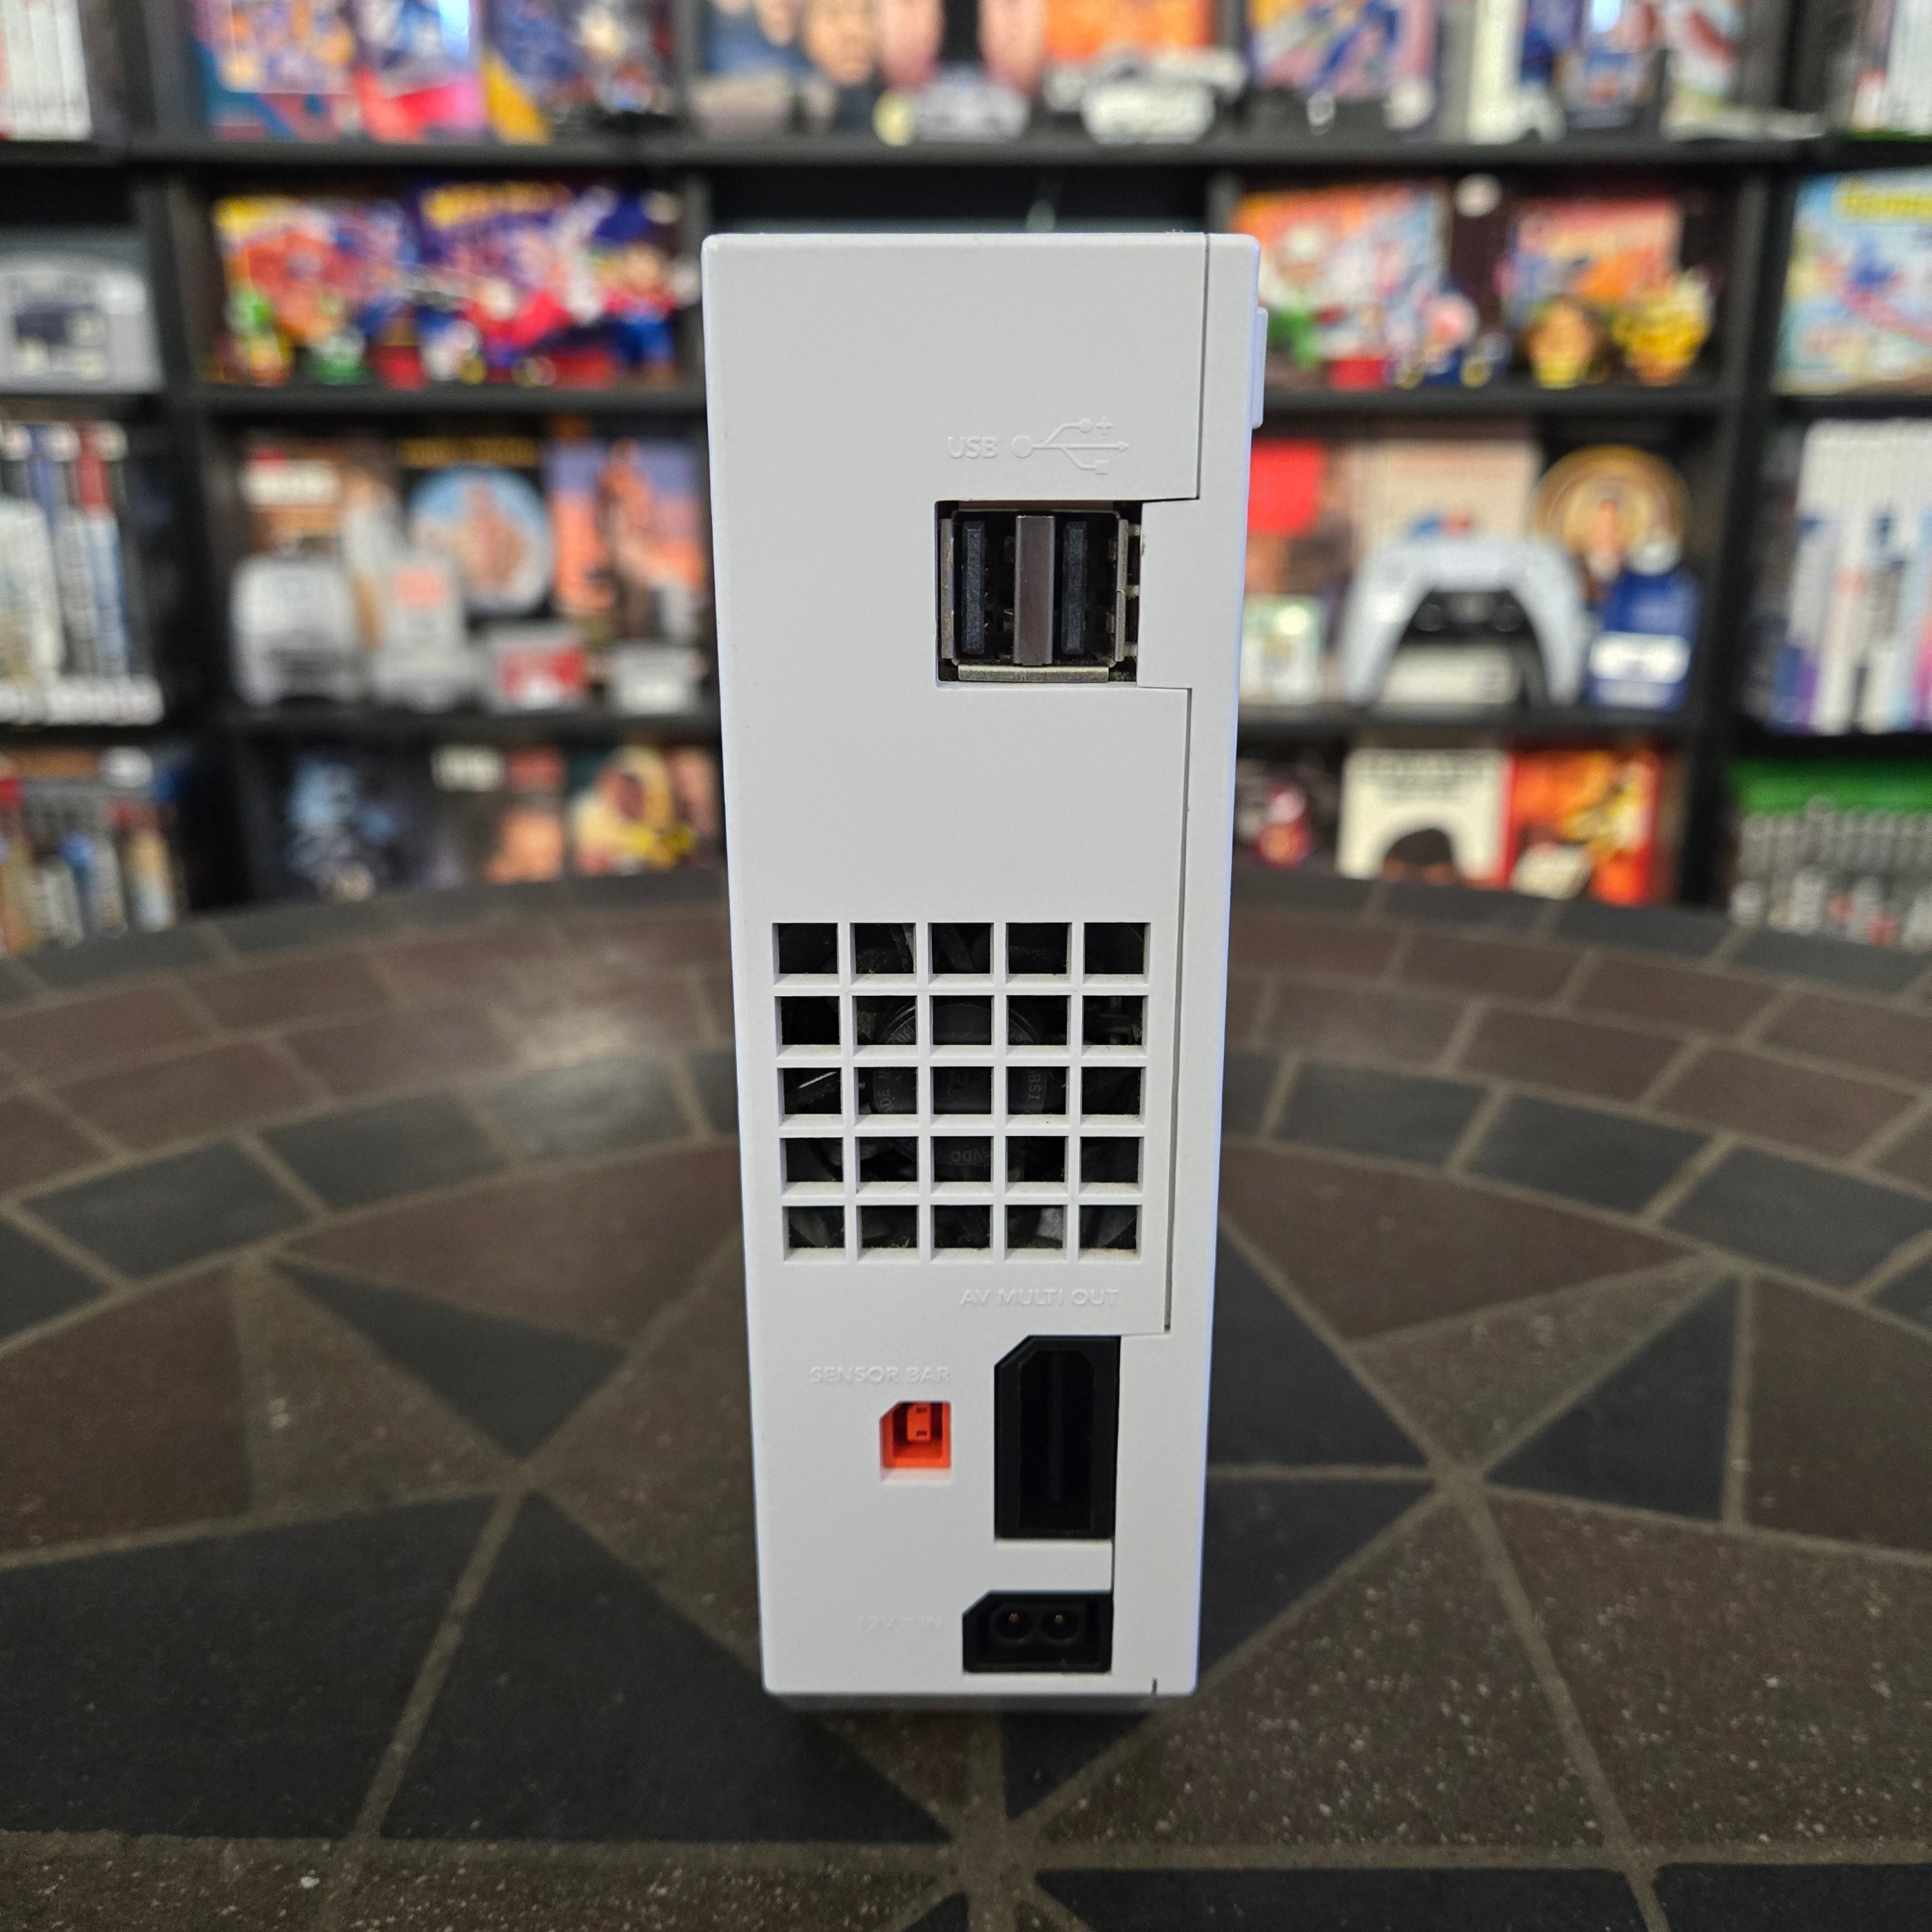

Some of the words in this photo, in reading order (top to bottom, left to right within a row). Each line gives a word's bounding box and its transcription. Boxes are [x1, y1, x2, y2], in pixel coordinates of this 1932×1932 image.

[947, 435, 998, 459] USB
[960, 1288, 991, 1306] AV
[997, 1288, 1064, 1306] MULTI
[1070, 1288, 1120, 1306] OUT
[810, 1366, 899, 1383] SENSOR
[906, 1366, 951, 1383] BAR
